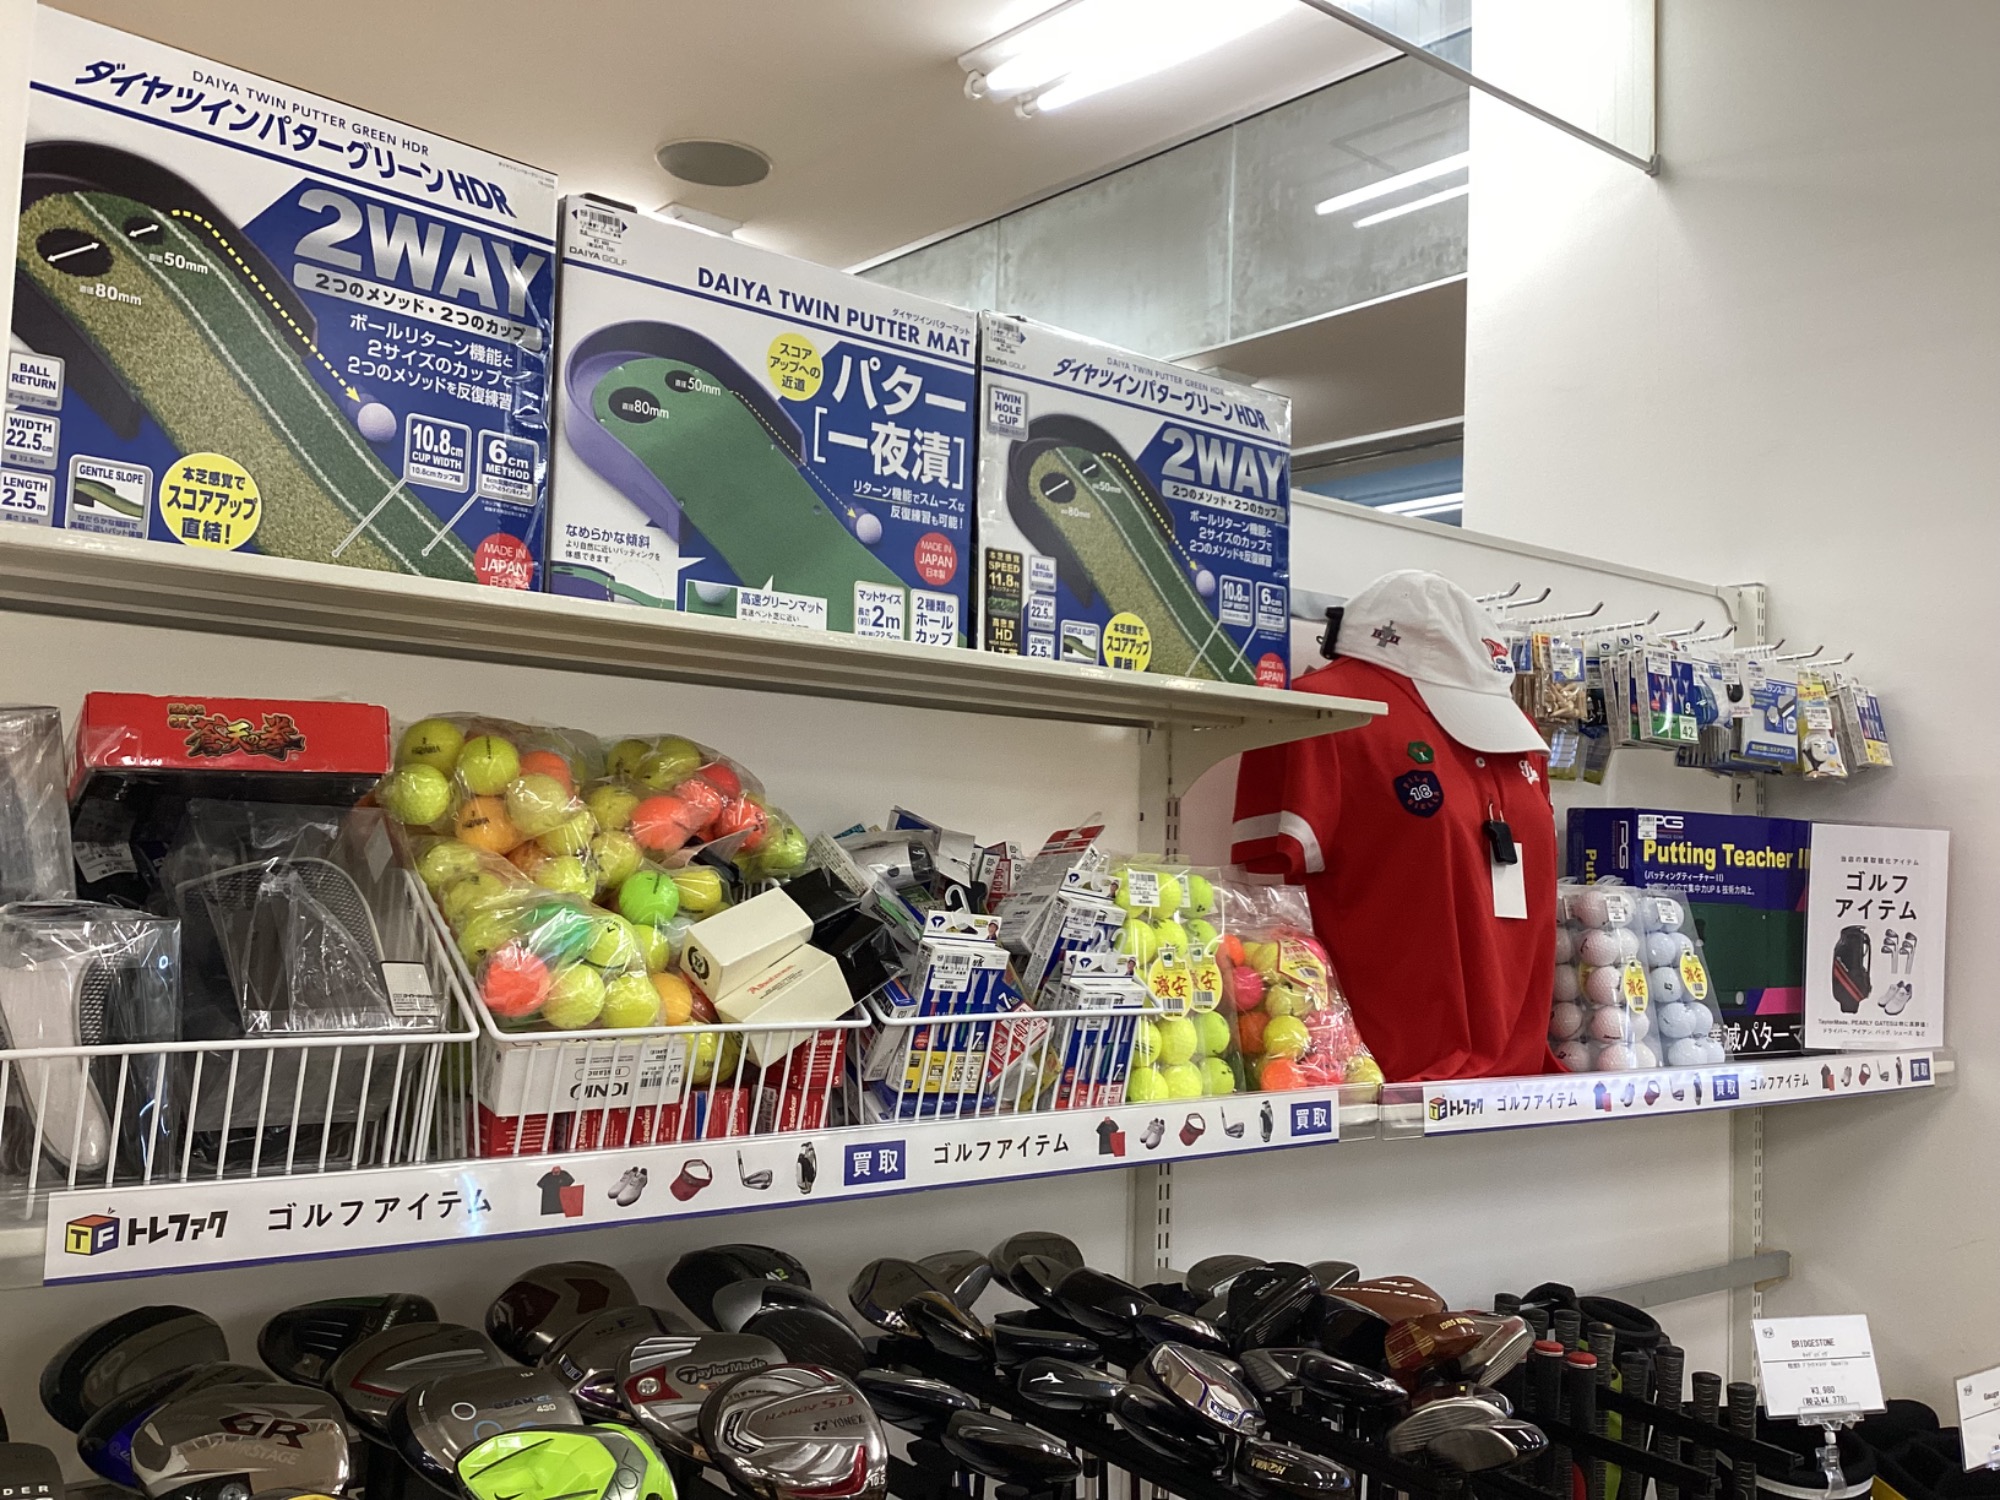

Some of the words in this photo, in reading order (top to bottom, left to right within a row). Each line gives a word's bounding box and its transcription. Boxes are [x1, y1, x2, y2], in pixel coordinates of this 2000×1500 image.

[193, 70, 240, 96] DAIYA
[246, 87, 287, 111] TWIN
[292, 102, 347, 130] PUTTER
[351, 123, 398, 146] GREEN
[402, 138, 430, 157] HDR
[75, 60, 518, 219] ダイヤツインパターグリーンHDR
[293, 188, 546, 318] 2WAY
[569, 245, 601, 261] DAIYA
[602, 254, 628, 267] GOLF
[315, 272, 526, 341] 2つのメソッド・2つのカップ
[698, 266, 773, 306] DAIYA
[779, 289, 840, 324] TWIN
[847, 308, 920, 345] PUTTER
[927, 330, 971, 358] MAT
[892, 308, 971, 336] ダイヤツインパターマット
[350, 312, 514, 370] ボールリターン機能と
[779, 342, 813, 360] スコア
[20, 362, 51, 378] BALL
[367, 338, 512, 388] 2サイズのカップで
[770, 355, 821, 380] アップへの
[1107, 357, 1130, 370] DAIYA
[1133, 364, 1153, 377] TWIN
[1155, 370, 1183, 385] PUTTER
[1185, 379, 1209, 391] GREEN
[11, 373, 57, 391] RETURN
[347, 355, 512, 412] 2つのメソッドを反復練習
[781, 374, 806, 392] 近道
[832, 354, 967, 415] パター
[995, 390, 1022, 405] TWIN
[1053, 358, 1271, 432] ダイヤツインパターグリーンHDR
[994, 401, 1022, 416] HOLE
[997, 413, 1019, 426] CUP
[9, 417, 53, 434] WIDTH
[5, 428, 53, 453] 22.5cm
[412, 422, 464, 459] 10.8cm
[412, 452, 431, 465] CUP
[432, 455, 462, 470] WIDTH
[488, 440, 529, 470] 6cm
[1161, 427, 1283, 501] 2WAY
[79, 464, 114, 480] GENTLE
[116, 471, 144, 485] SLOPE
[182, 466, 246, 491] 本芝感覚で
[485, 462, 531, 481] METHOD
[3, 476, 48, 492] LENGTH
[853, 479, 966, 512] リターン機能でスムーズな
[1, 488, 46, 512] 2.5m
[167, 485, 258, 521] スコアアップ
[1172, 485, 1278, 518] 2つのメソッド・2つのカップ
[1189, 510, 1273, 538] ボールリターン機能と
[565, 523, 651, 549] なめらかな傾斜
[921, 539, 942, 551] MADE
[942, 542, 952, 554] IN
[1199, 527, 1273, 553] 2サイズのカップで
[484, 542, 514, 557] MADE
[515, 547, 526, 560] IN
[565, 539, 660, 562] より自然に近いパッティングを
[919, 551, 954, 569] JAPAN
[481, 557, 528, 578] JAPAN
[925, 567, 946, 580] 日本製
[988, 561, 1020, 574] SPEED
[1035, 562, 1050, 571] BALL
[740, 592, 824, 615] 高速グリーンマット
[858, 589, 903, 606] マットサイズ
[917, 596, 954, 614] 2種類の
[1261, 588, 1283, 607] 6cm
[857, 606, 870, 617] 長さ
[871, 605, 901, 629] 2m
[916, 613, 953, 629] ホール
[915, 629, 953, 646] カップ
[995, 629, 1013, 641] HD
[1031, 636, 1052, 646] LENGTH
[1106, 635, 1150, 656] スコアアップ
[1410, 783, 1434, 801] 18
[1643, 840, 1717, 871] Putting
[1722, 844, 1793, 868] Teacher
[1846, 870, 1909, 894] ゴルフ
[1835, 898, 1917, 921] アイテム
[1450, 1098, 1484, 1117] トレファク
[1497, 1092, 1578, 1112] ゴルフアイテム
[1715, 1079, 1737, 1097] 買取
[1750, 1073, 1810, 1091] ゴルフアイテム
[1912, 1062, 1929, 1078] 買取
[127, 1210, 229, 1246] トレファク
[268, 1188, 492, 1231] ゴルフアイテム
[852, 1149, 899, 1178] 買取
[934, 1132, 1069, 1165] ゴルフアイテム
[1296, 1107, 1327, 1130] 買取
[1791, 1337, 1836, 1349] BRIDGESTONE
[675, 1358, 768, 1385] TaylorMade
[218, 1412, 311, 1449] GR
[832, 1414, 865, 1429] YONEX
